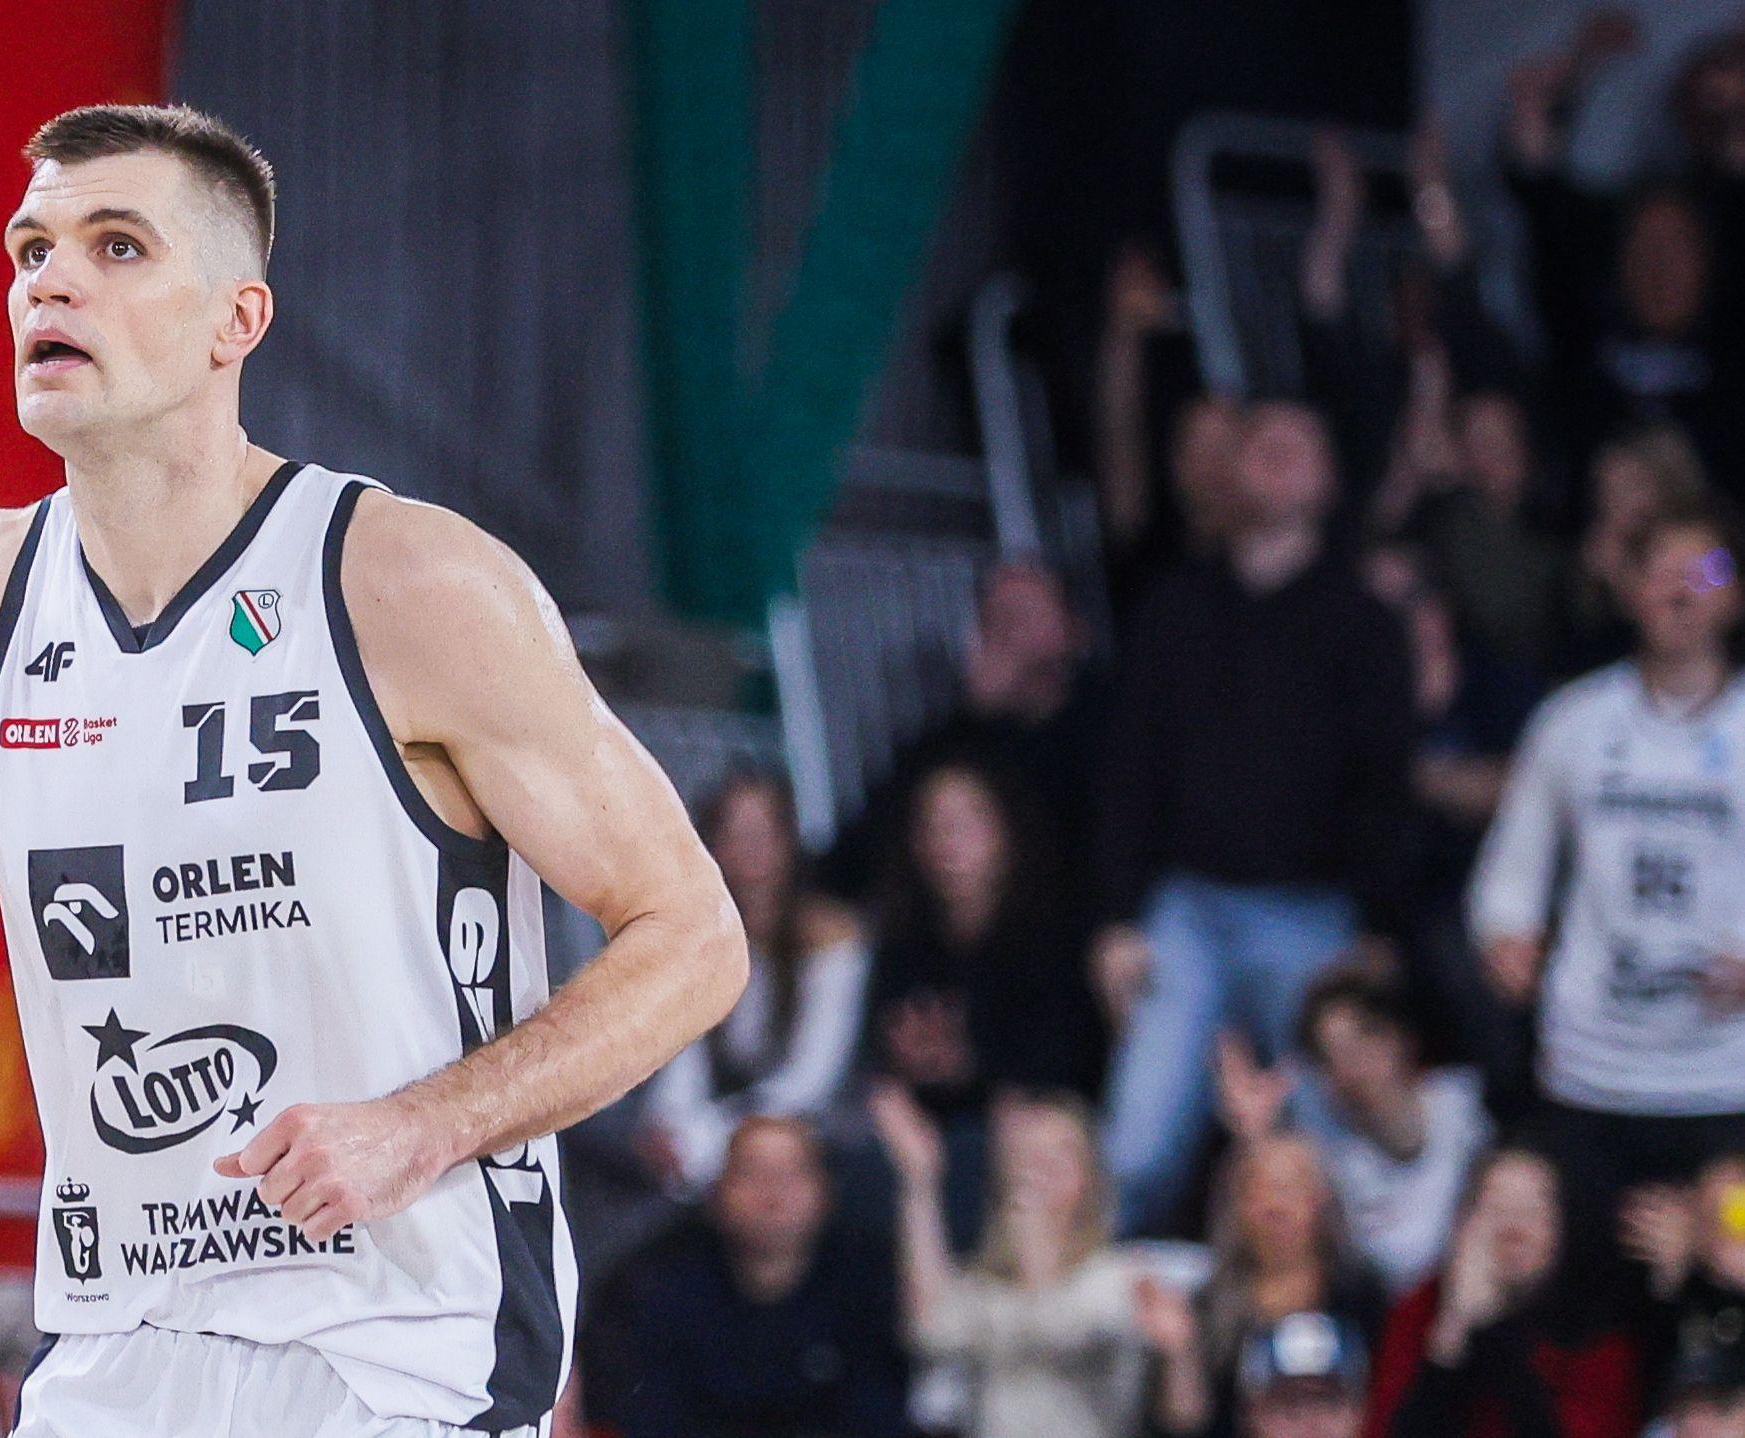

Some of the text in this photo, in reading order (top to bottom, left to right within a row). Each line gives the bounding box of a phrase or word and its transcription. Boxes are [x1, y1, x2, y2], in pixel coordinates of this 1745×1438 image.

[25, 642, 75, 682] 4F
[83, 716, 117, 729] Basket
[83, 731, 103, 745] Liga
[182, 689, 321, 804] 15
[153, 851, 296, 904] ORLEN
[156, 900, 312, 944] TERMIKA
[112, 1047, 235, 1129] LOTTO
